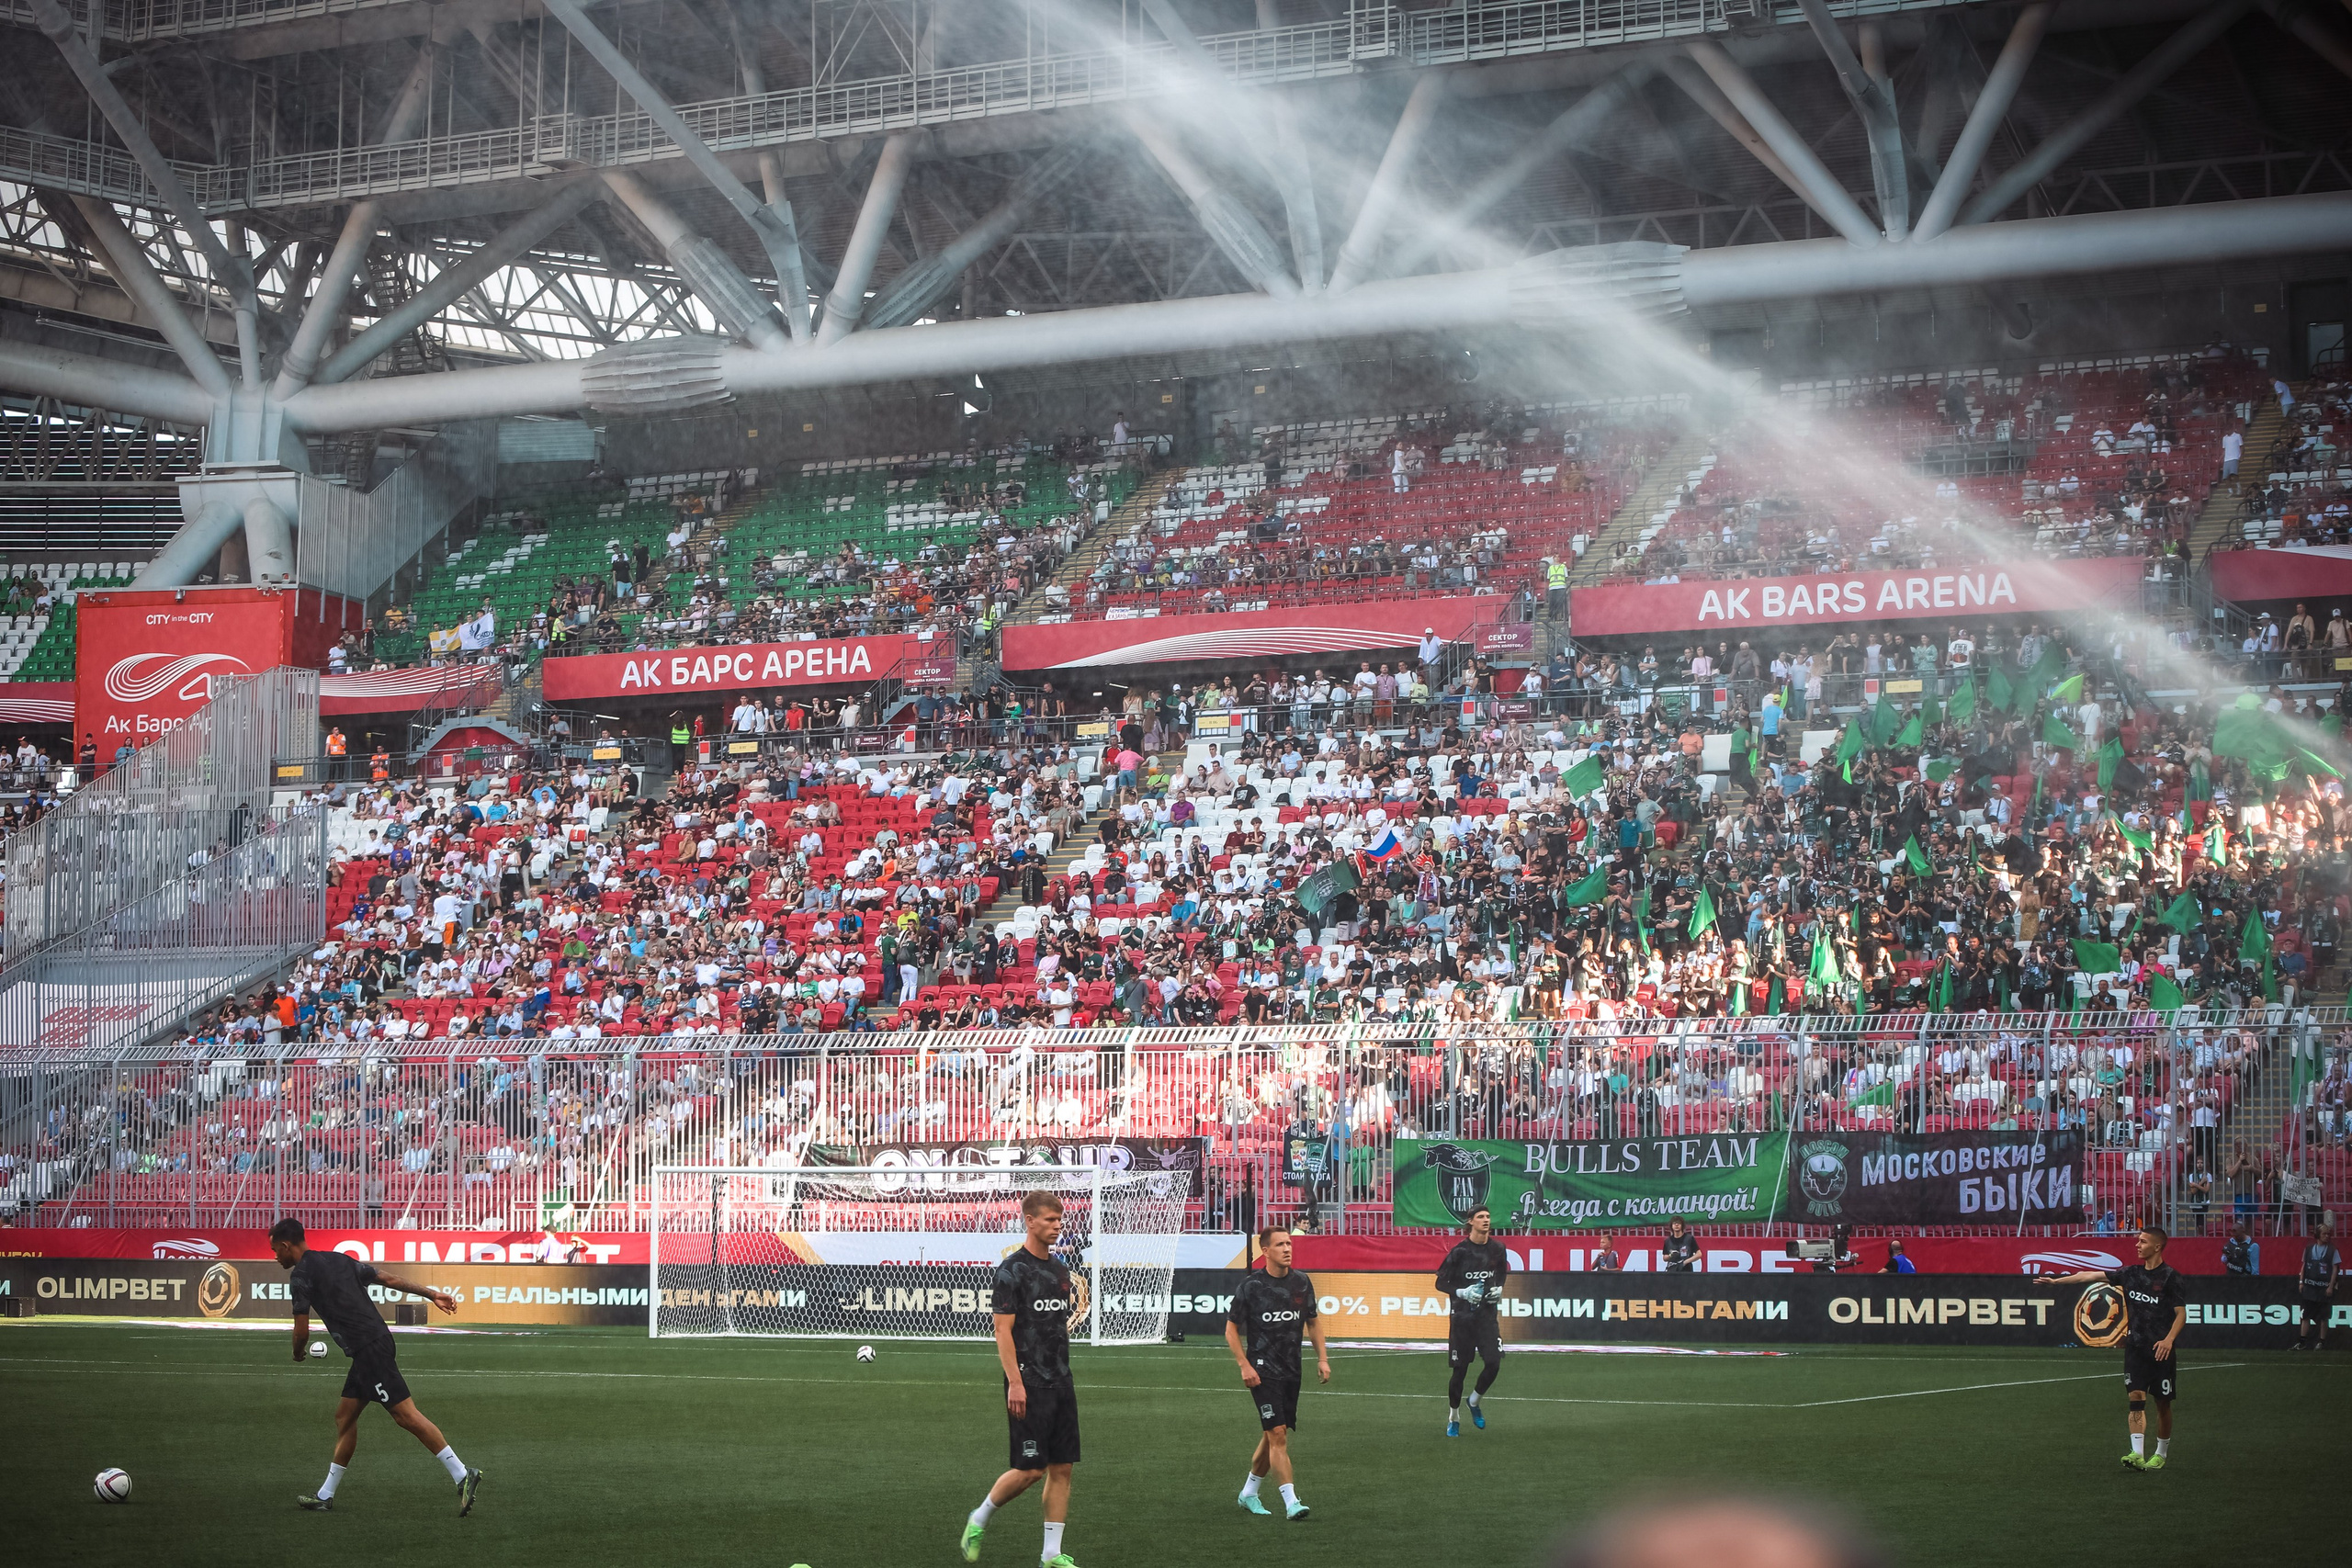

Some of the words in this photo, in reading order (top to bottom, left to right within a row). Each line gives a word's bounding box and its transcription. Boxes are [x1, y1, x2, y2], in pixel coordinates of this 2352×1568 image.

[1699, 588, 1750, 622] AK
[1762, 581, 1866, 618] BARS
[1876, 572, 2017, 612] ARENA
[146, 615, 170, 625] CITY
[189, 613, 214, 624] CITY
[1488, 634, 1518, 642] СЕКТОР
[620, 658, 662, 689] АК
[671, 652, 754, 685] БАРС
[762, 645, 872, 680] АРЕНА
[914, 668, 941, 676] СЕКТОР
[105, 715, 131, 734] Ак
[136, 714, 184, 737] Барс
[1523, 1143, 1641, 1174] BULLS
[1653, 1137, 1759, 1171] TEAM
[1799, 1140, 1849, 1159] MOSCOW
[986, 1145, 1136, 1193] TUR
[1453, 1177, 1475, 1197] FAN
[1959, 1165, 2072, 1214] БЫКИ
[1608, 1198, 1621, 1217] с
[1624, 1187, 1759, 1221] командой!
[1806, 1200, 1843, 1217] BULLS
[1464, 1269, 1495, 1280] OZON
[37, 1276, 187, 1301] OLIMPBET
[474, 1287, 649, 1306] РЕАЛЬНЫМИ
[2129, 1290, 2159, 1305] OZON
[1034, 1298, 1068, 1312] OZON
[1316, 1295, 1370, 1316] 0%
[1602, 1297, 1789, 1321] ДЕНЬГАМИ
[1827, 1296, 2056, 1325] OLIMPBET
[1261, 1310, 1302, 1323] OZON
[374, 1382, 390, 1403] 5
